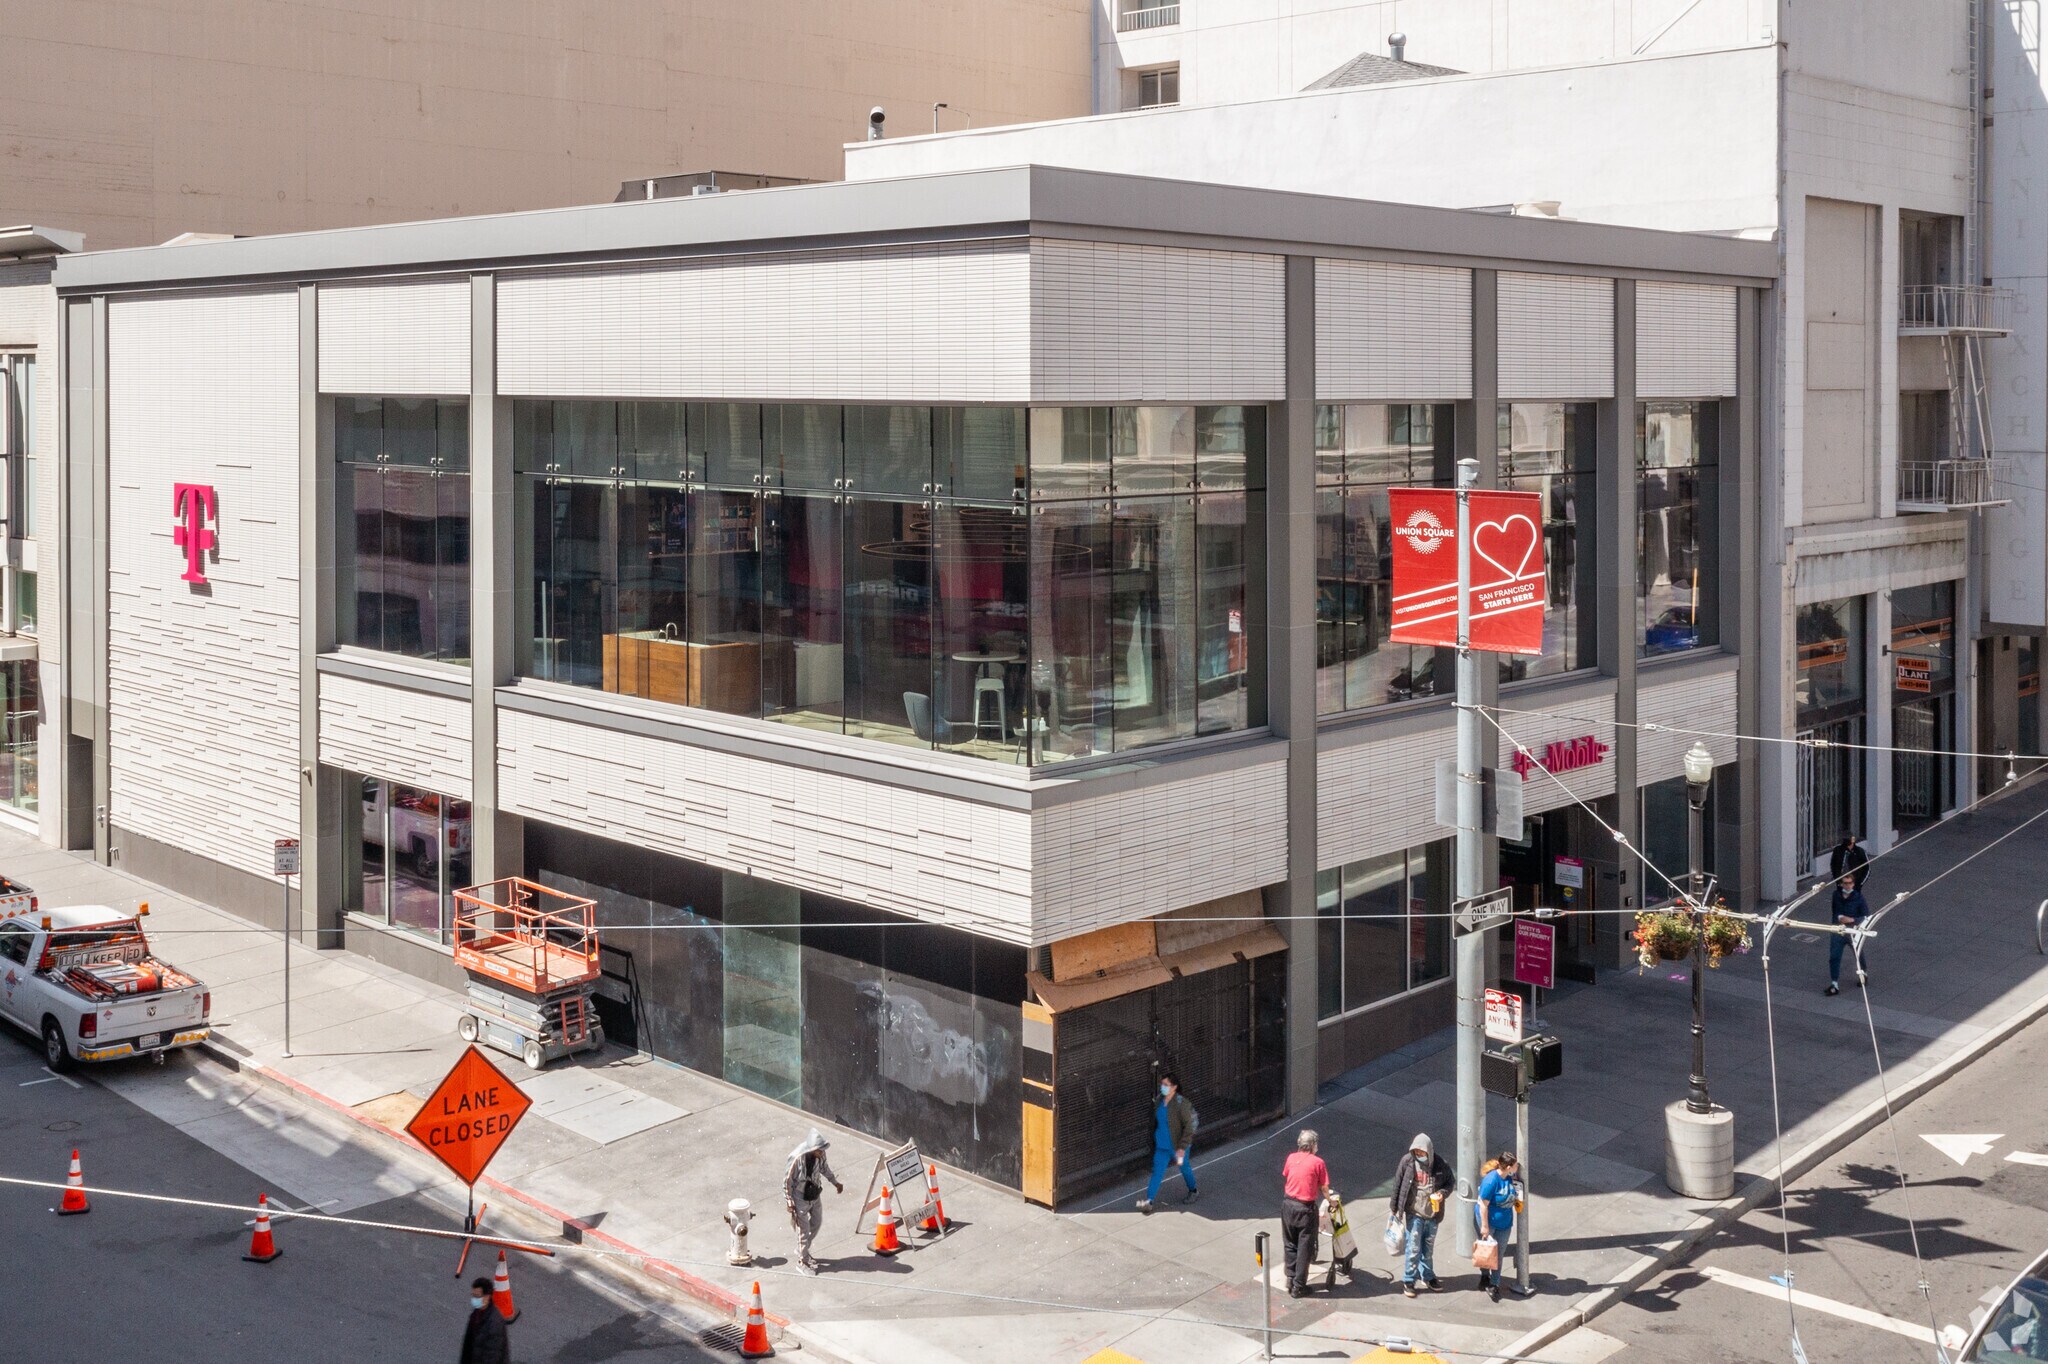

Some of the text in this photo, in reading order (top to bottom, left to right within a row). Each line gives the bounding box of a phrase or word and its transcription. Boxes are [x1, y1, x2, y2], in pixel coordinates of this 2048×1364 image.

[173, 482, 214, 584] T
[1395, 526, 1455, 538] UNION SQUARE
[1479, 583, 1535, 602] SAN FRANCISCO
[1483, 591, 1534, 610] STARTS HERE
[1512, 735, 1609, 781] T-Mobile
[1471, 900, 1506, 922] ONE WAY
[1518, 924, 1534, 934] SAFETY
[1529, 932, 1551, 941] PRIORITY
[93, 952, 121, 963] KEEP
[1486, 1002, 1498, 1013] NO
[1488, 1014, 1518, 1030] ANY TIME
[443, 1087, 499, 1115] LANE
[429, 1113, 511, 1147] CLOSED
